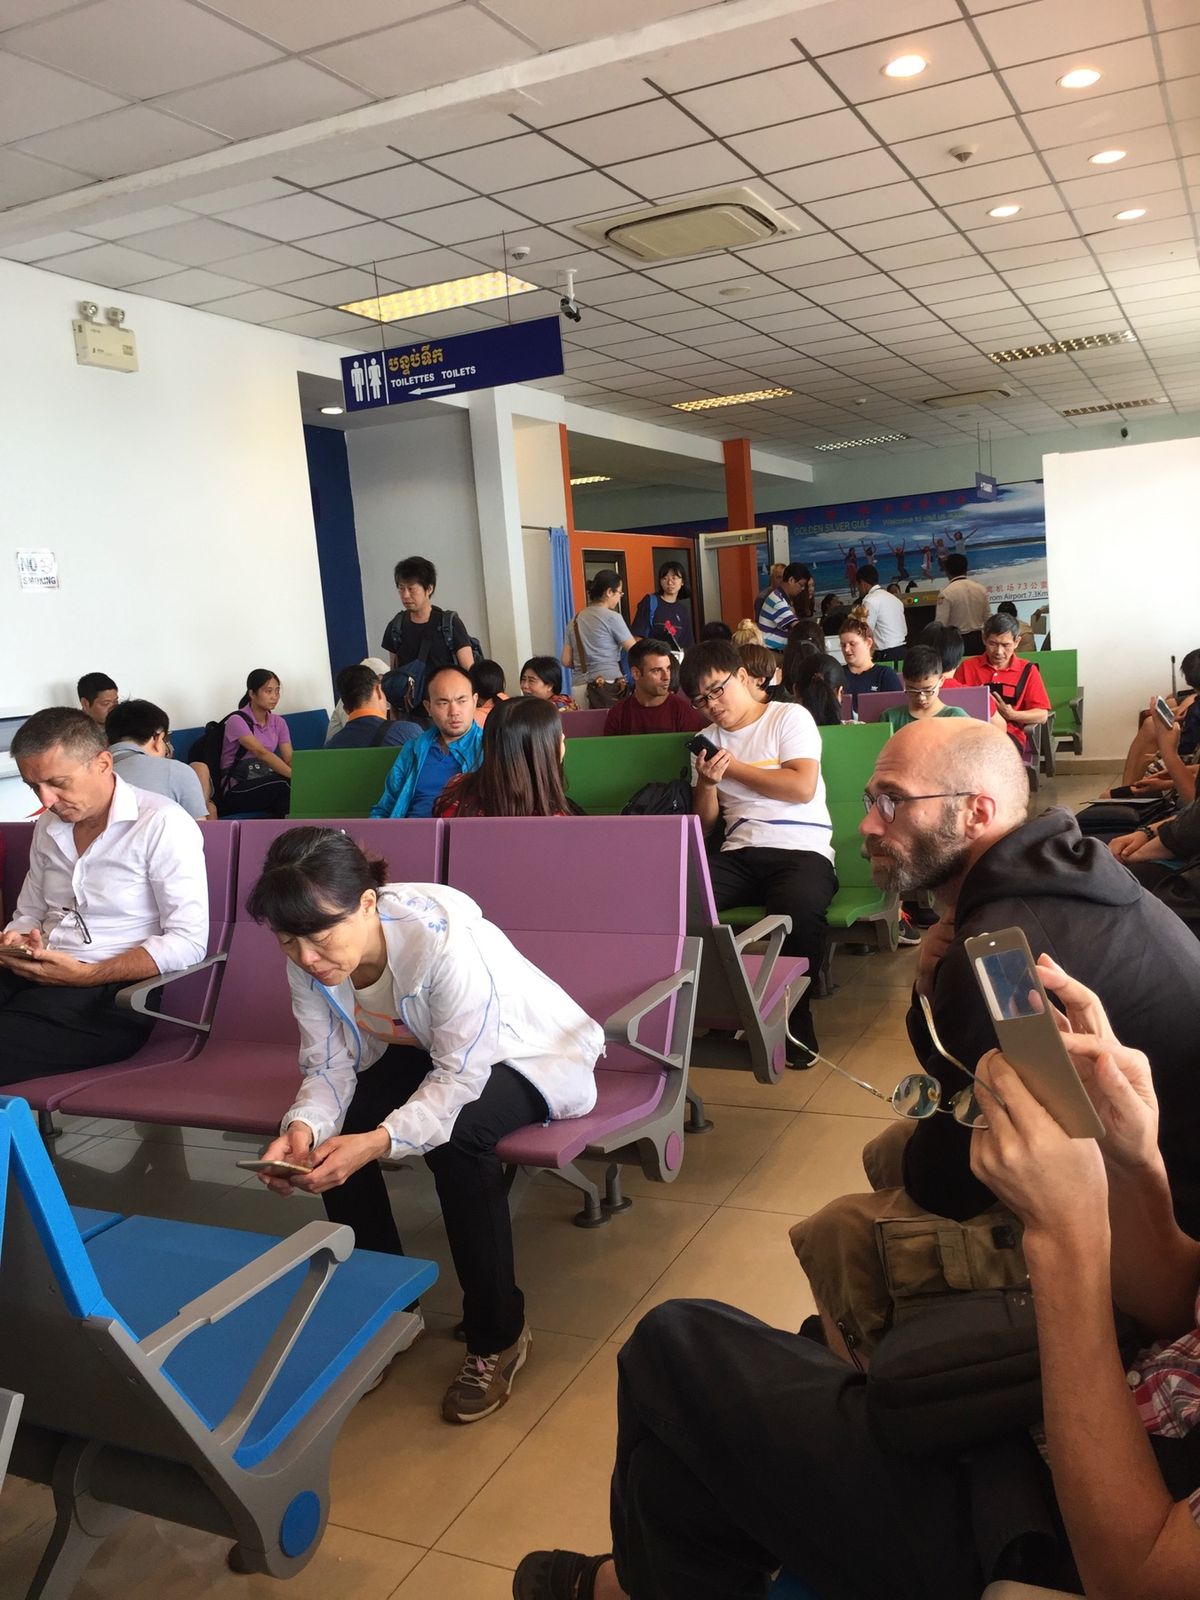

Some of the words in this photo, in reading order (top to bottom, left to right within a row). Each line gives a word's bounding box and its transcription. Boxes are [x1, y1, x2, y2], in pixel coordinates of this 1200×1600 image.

[391, 373, 435, 388] TOILETTES
[441, 366, 476, 379] TOILETS
[793, 524, 824, 535] GOLDEN
[824, 521, 850, 531] SILVER
[851, 518, 872, 529] GULF
[882, 517, 913, 526] Welcome
[20, 557, 38, 572] NO
[23, 576, 57, 585] SMOKING
[1004, 592, 1027, 601] Airport
